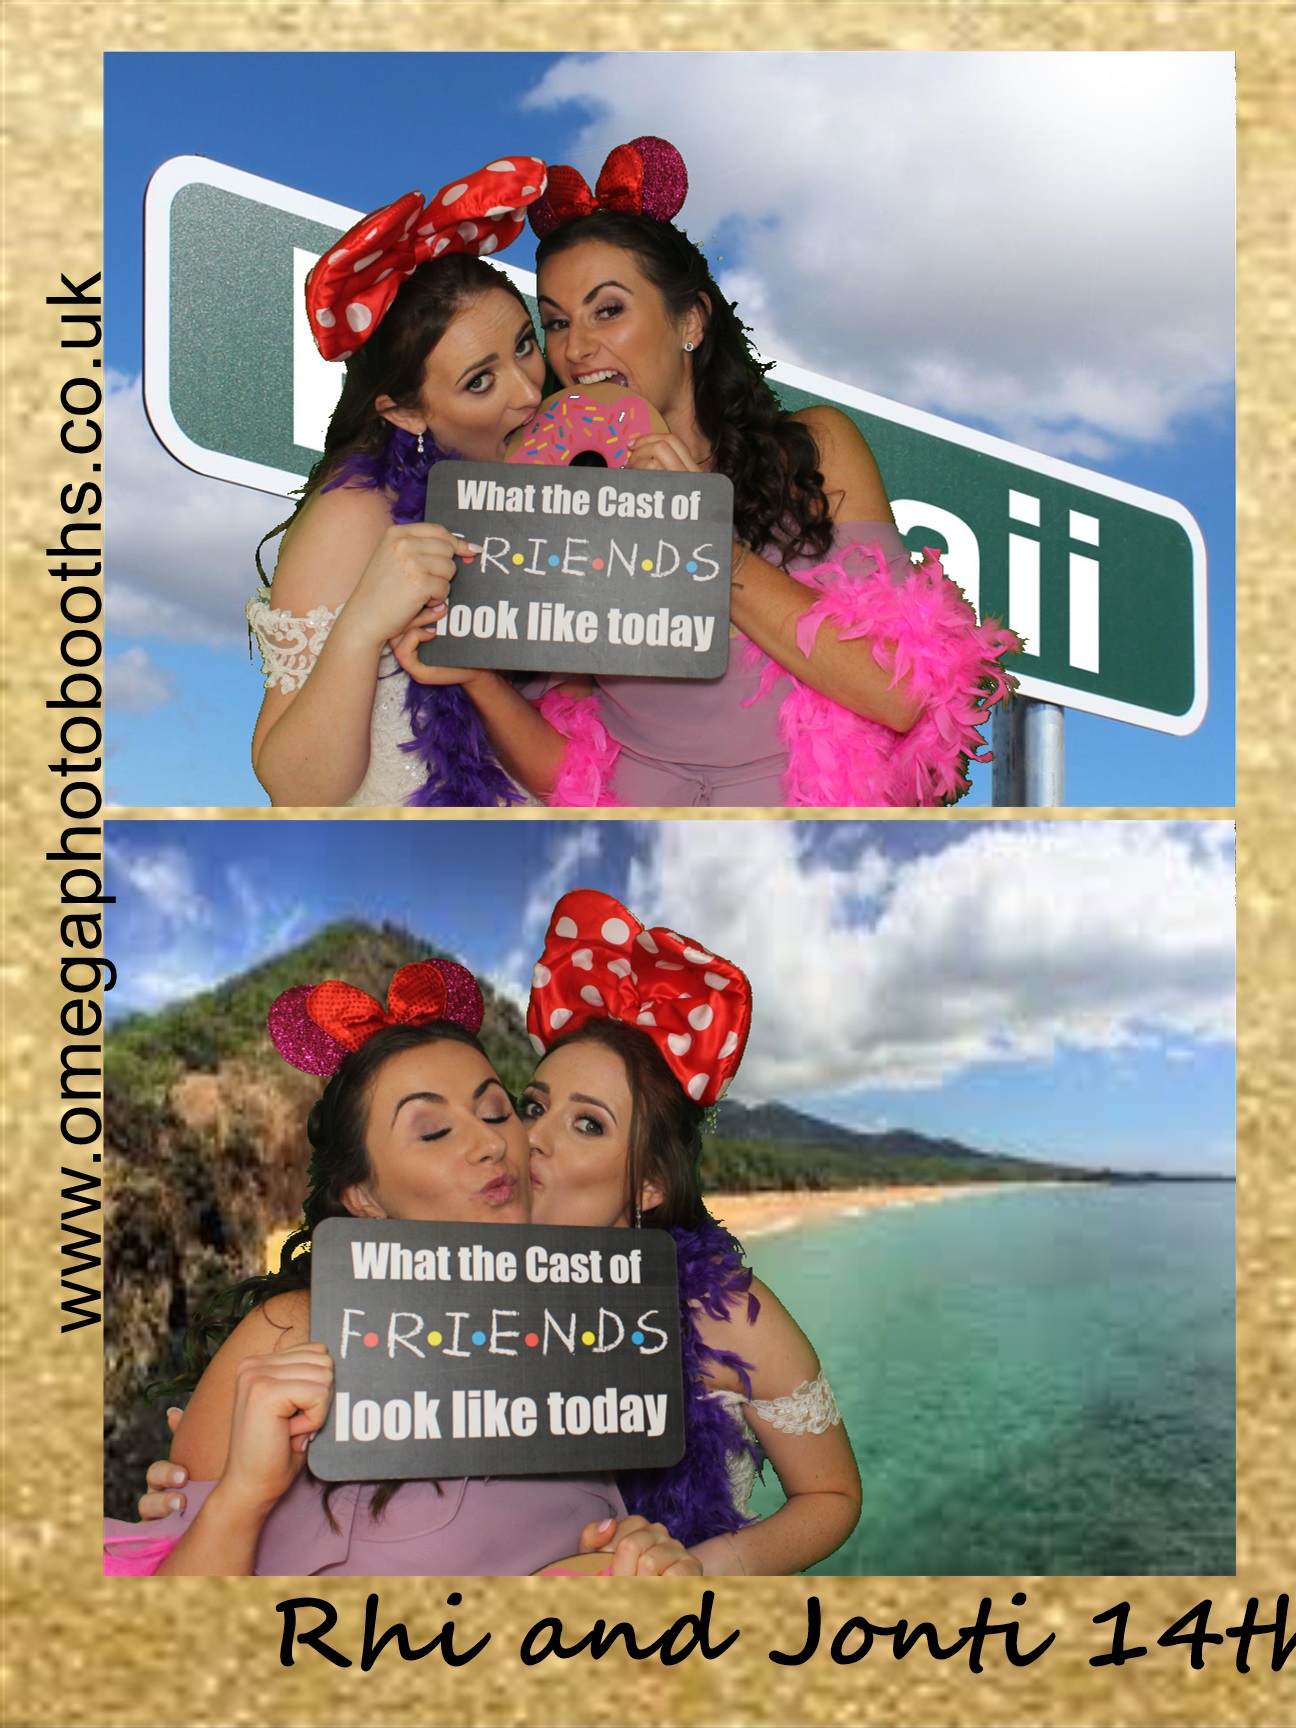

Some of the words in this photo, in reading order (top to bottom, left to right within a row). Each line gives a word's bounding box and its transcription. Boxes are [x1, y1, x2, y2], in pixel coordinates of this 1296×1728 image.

[457, 479, 536, 513] What
[541, 483, 591, 516] the
[597, 485, 666, 520] Cast
[670, 490, 702, 521] of
[526, 601, 599, 644] like
[606, 607, 716, 652] today
[350, 1241, 452, 1281] What
[457, 1244, 517, 1283] the
[525, 1245, 604, 1284] Cast
[609, 1249, 642, 1285] of
[334, 1390, 443, 1442] look
[452, 1389, 538, 1439] like
[546, 1387, 668, 1438] today
